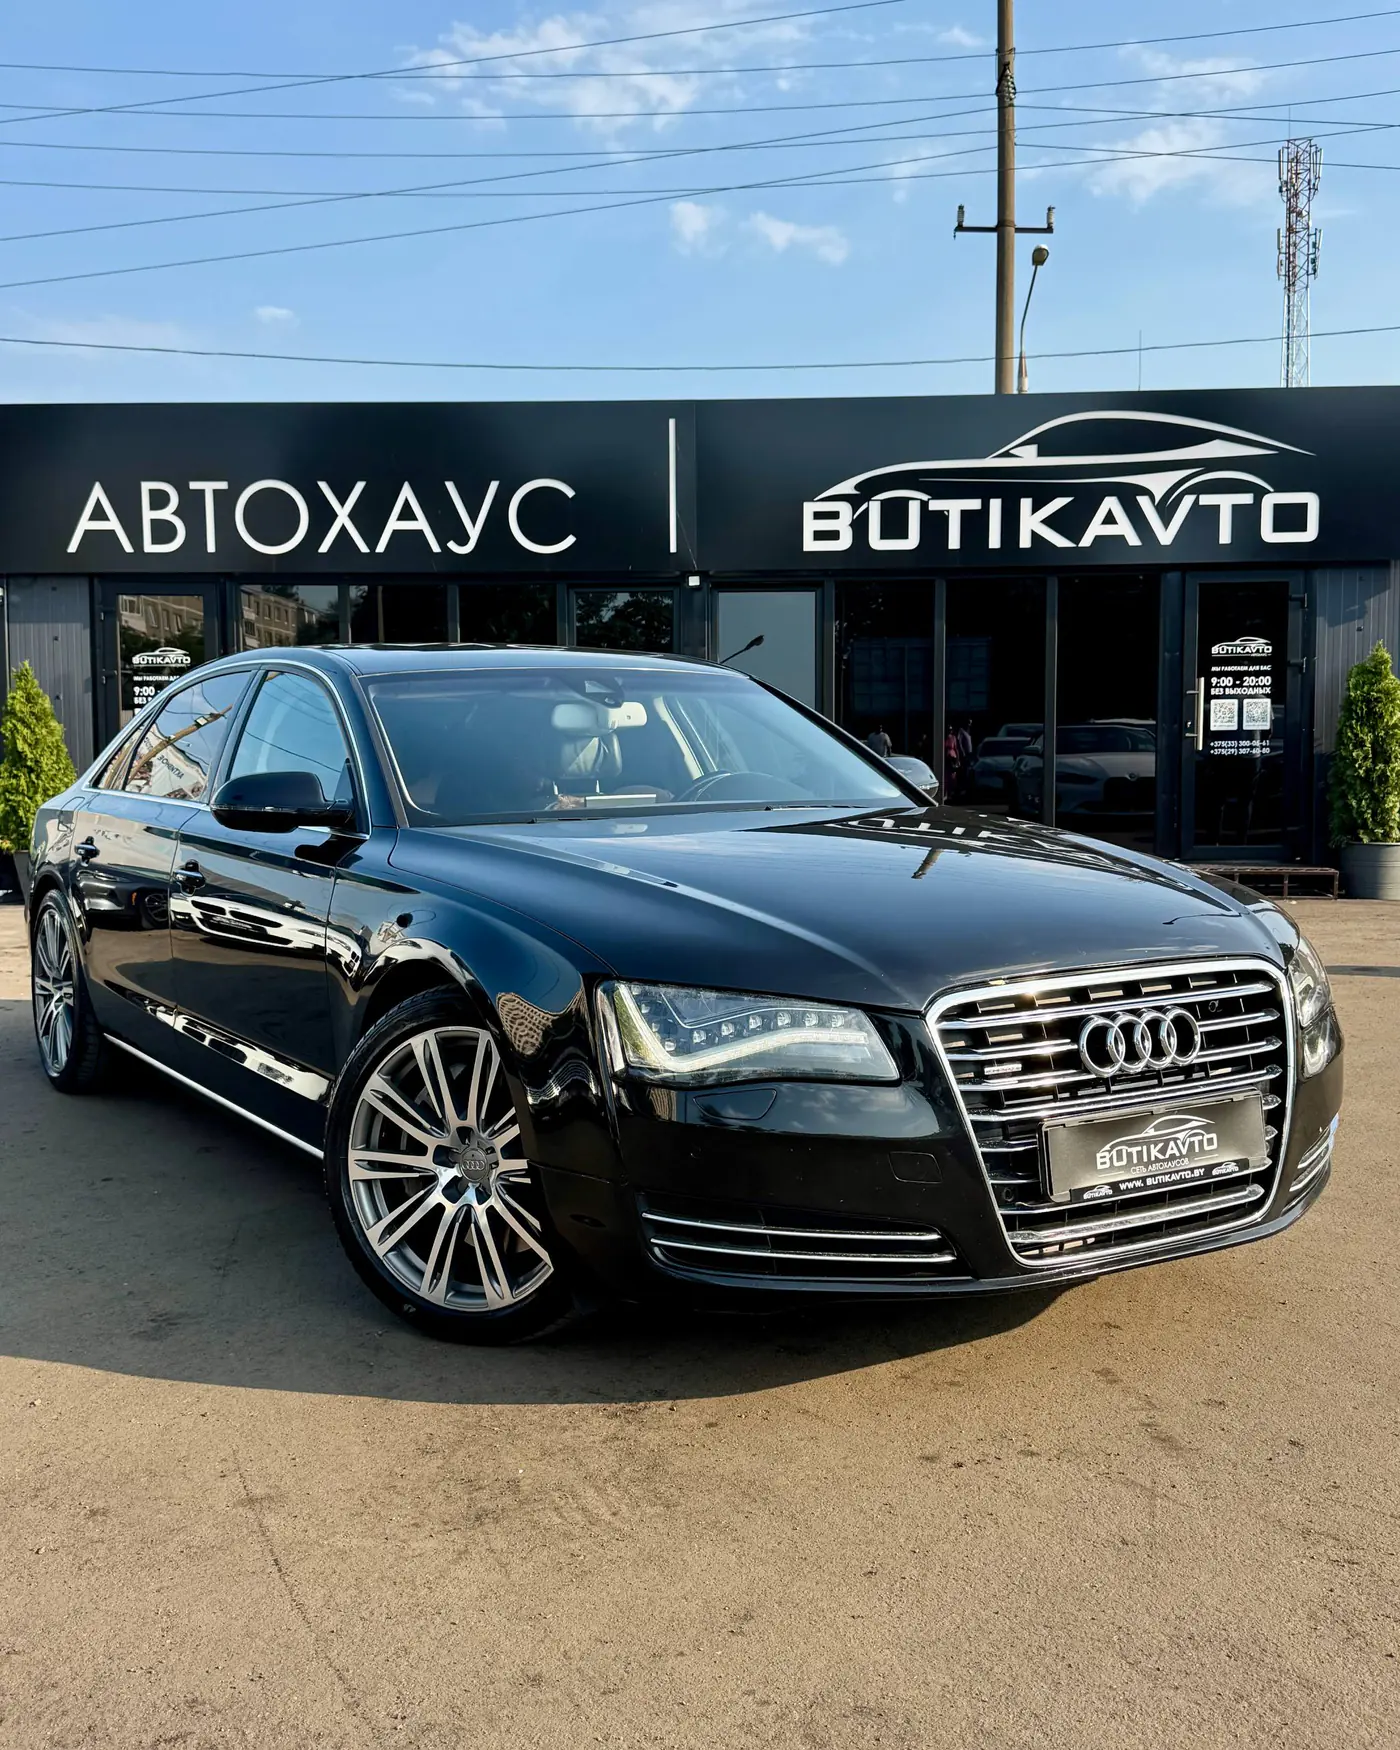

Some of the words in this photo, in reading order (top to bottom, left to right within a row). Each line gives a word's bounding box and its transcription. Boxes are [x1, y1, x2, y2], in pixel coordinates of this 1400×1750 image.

[66, 478, 577, 555] АВТОХАУС
[802, 490, 1320, 552] BUTIKAVTO
[1211, 645, 1273, 654] BUTIKAVTO
[132, 656, 191, 665] BUTIKAVTO
[1211, 676, 1234, 687] 9:00
[1243, 676, 1272, 687] 20:00
[133, 686, 156, 696] 9:00
[1211, 687, 1224, 695] БЕЗ
[1225, 687, 1272, 695] ВЫХОДНЫХ
[134, 696, 147, 704] БЕЗ
[1096, 1133, 1218, 1170] BUTIKAVTO
[1130, 1166, 1147, 1175] СЕТЬ
[1147, 1158, 1190, 1173] АВТОХАУСОВ
[1212, 1166, 1239, 1176] BUTIKAVTO
[1083, 1188, 1113, 1200] BUTIKAVTO
